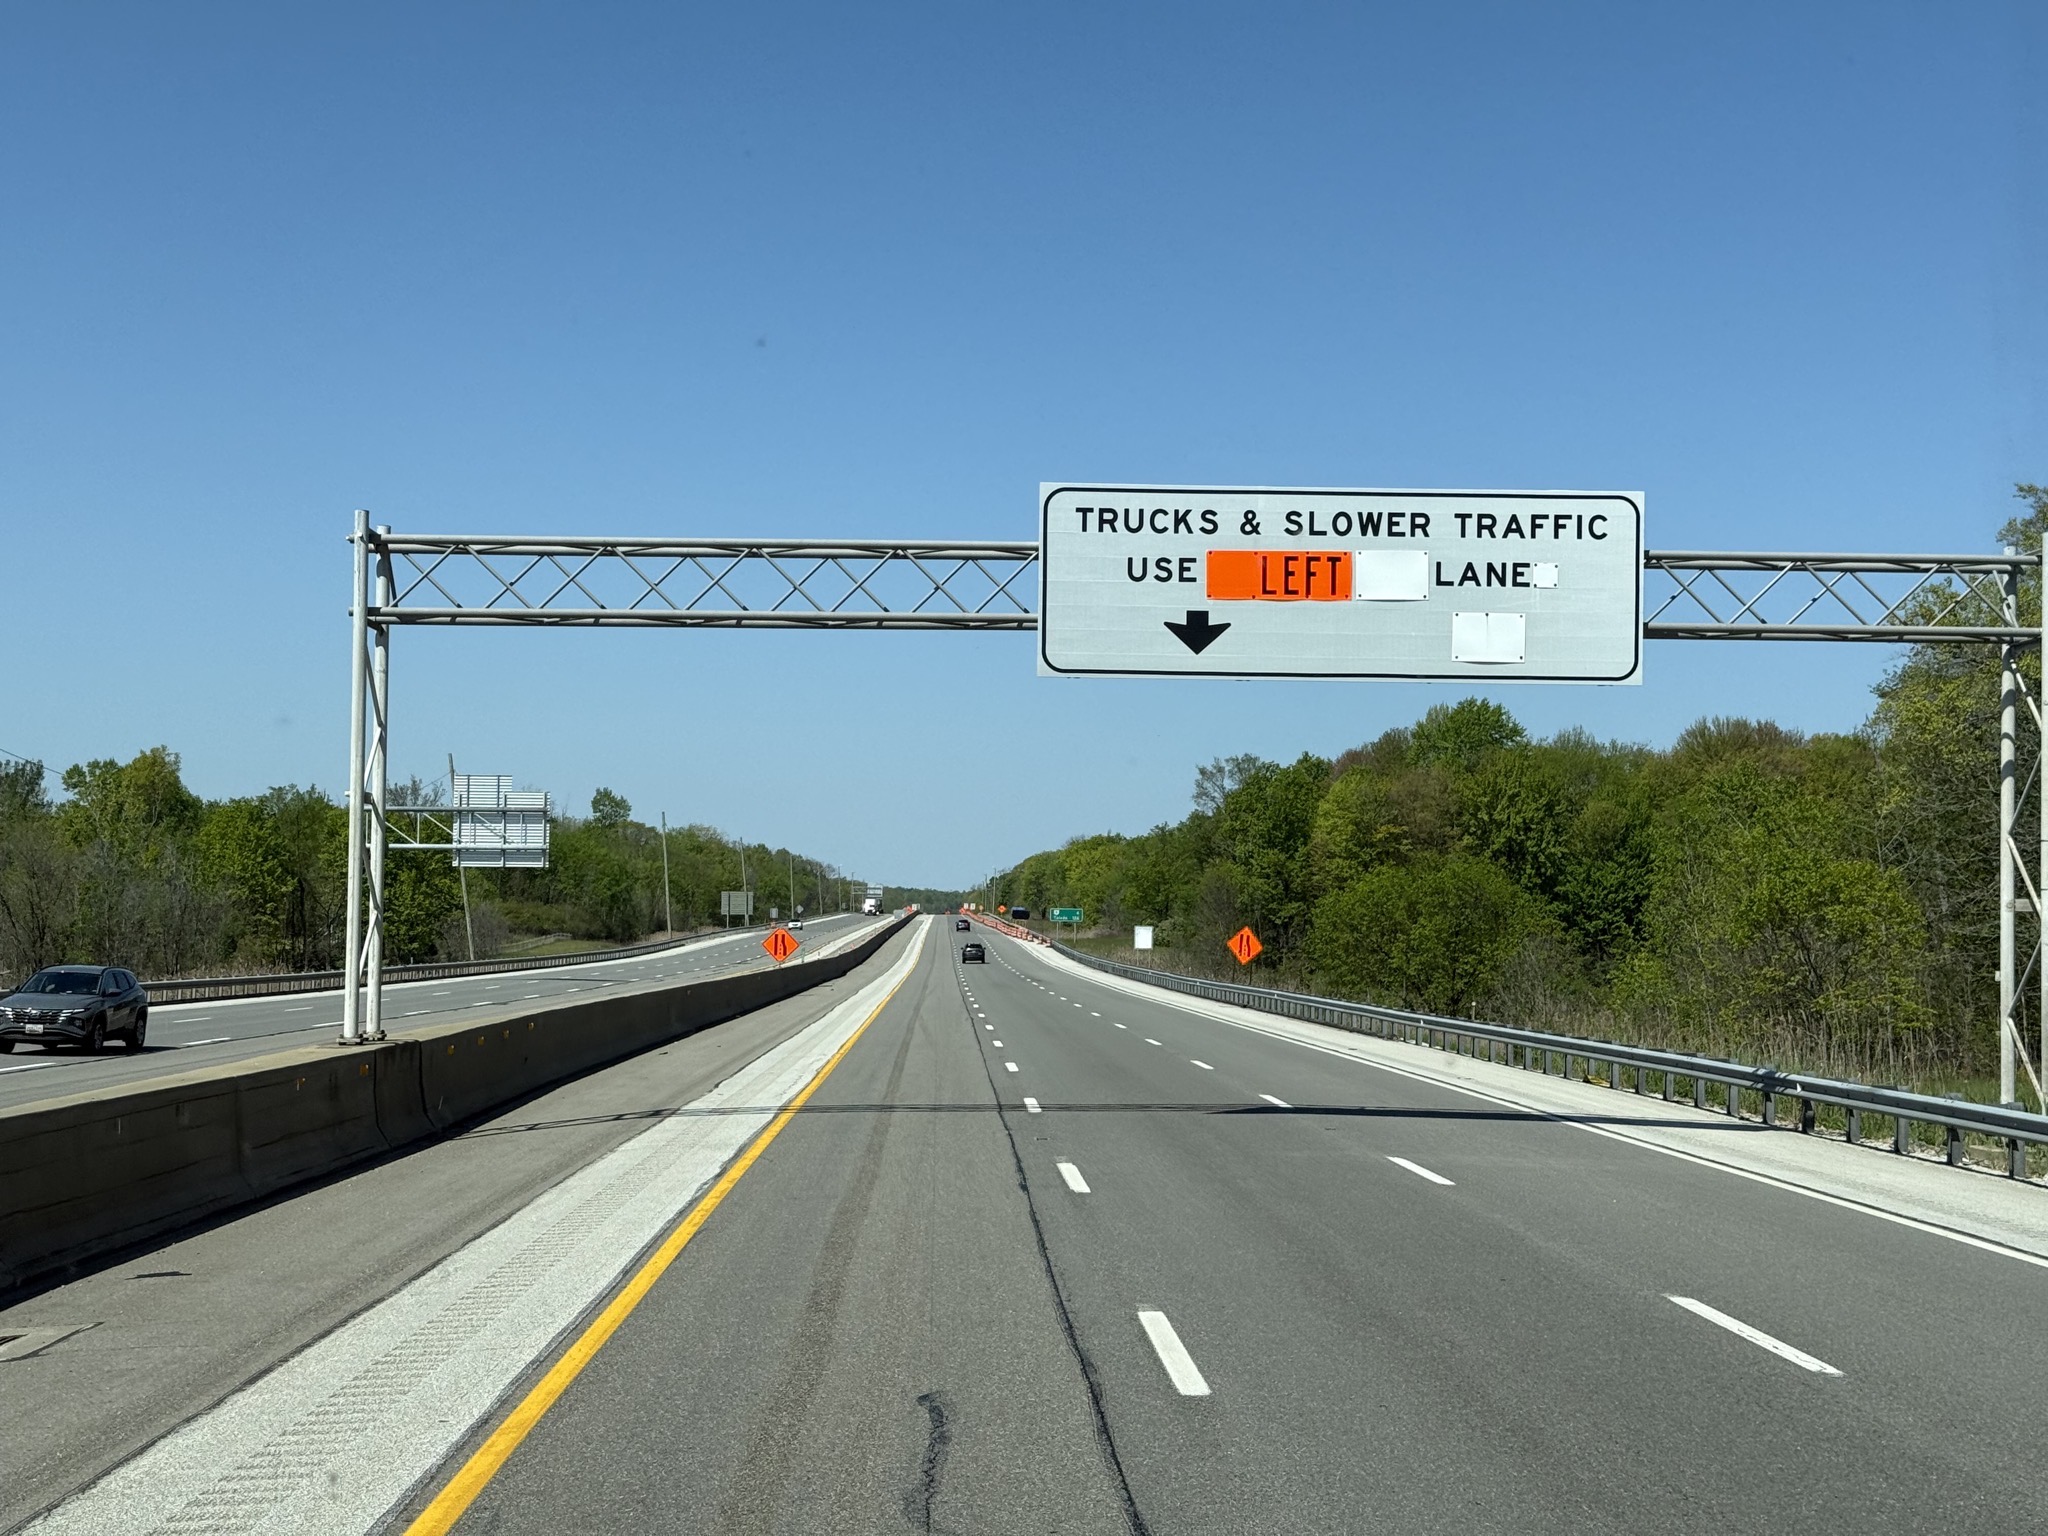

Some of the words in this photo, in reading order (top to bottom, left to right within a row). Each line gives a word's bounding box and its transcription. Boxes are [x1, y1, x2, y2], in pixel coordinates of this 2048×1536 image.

[1075, 507, 1219, 535] TRUCKS
[1239, 509, 1261, 536] &
[1283, 510, 1431, 538] SLOWER
[1454, 512, 1608, 541] TRAFFIC
[1127, 556, 1197, 583] USE
[1261, 555, 1342, 596] LEFT
[1435, 561, 1531, 588] LANE
